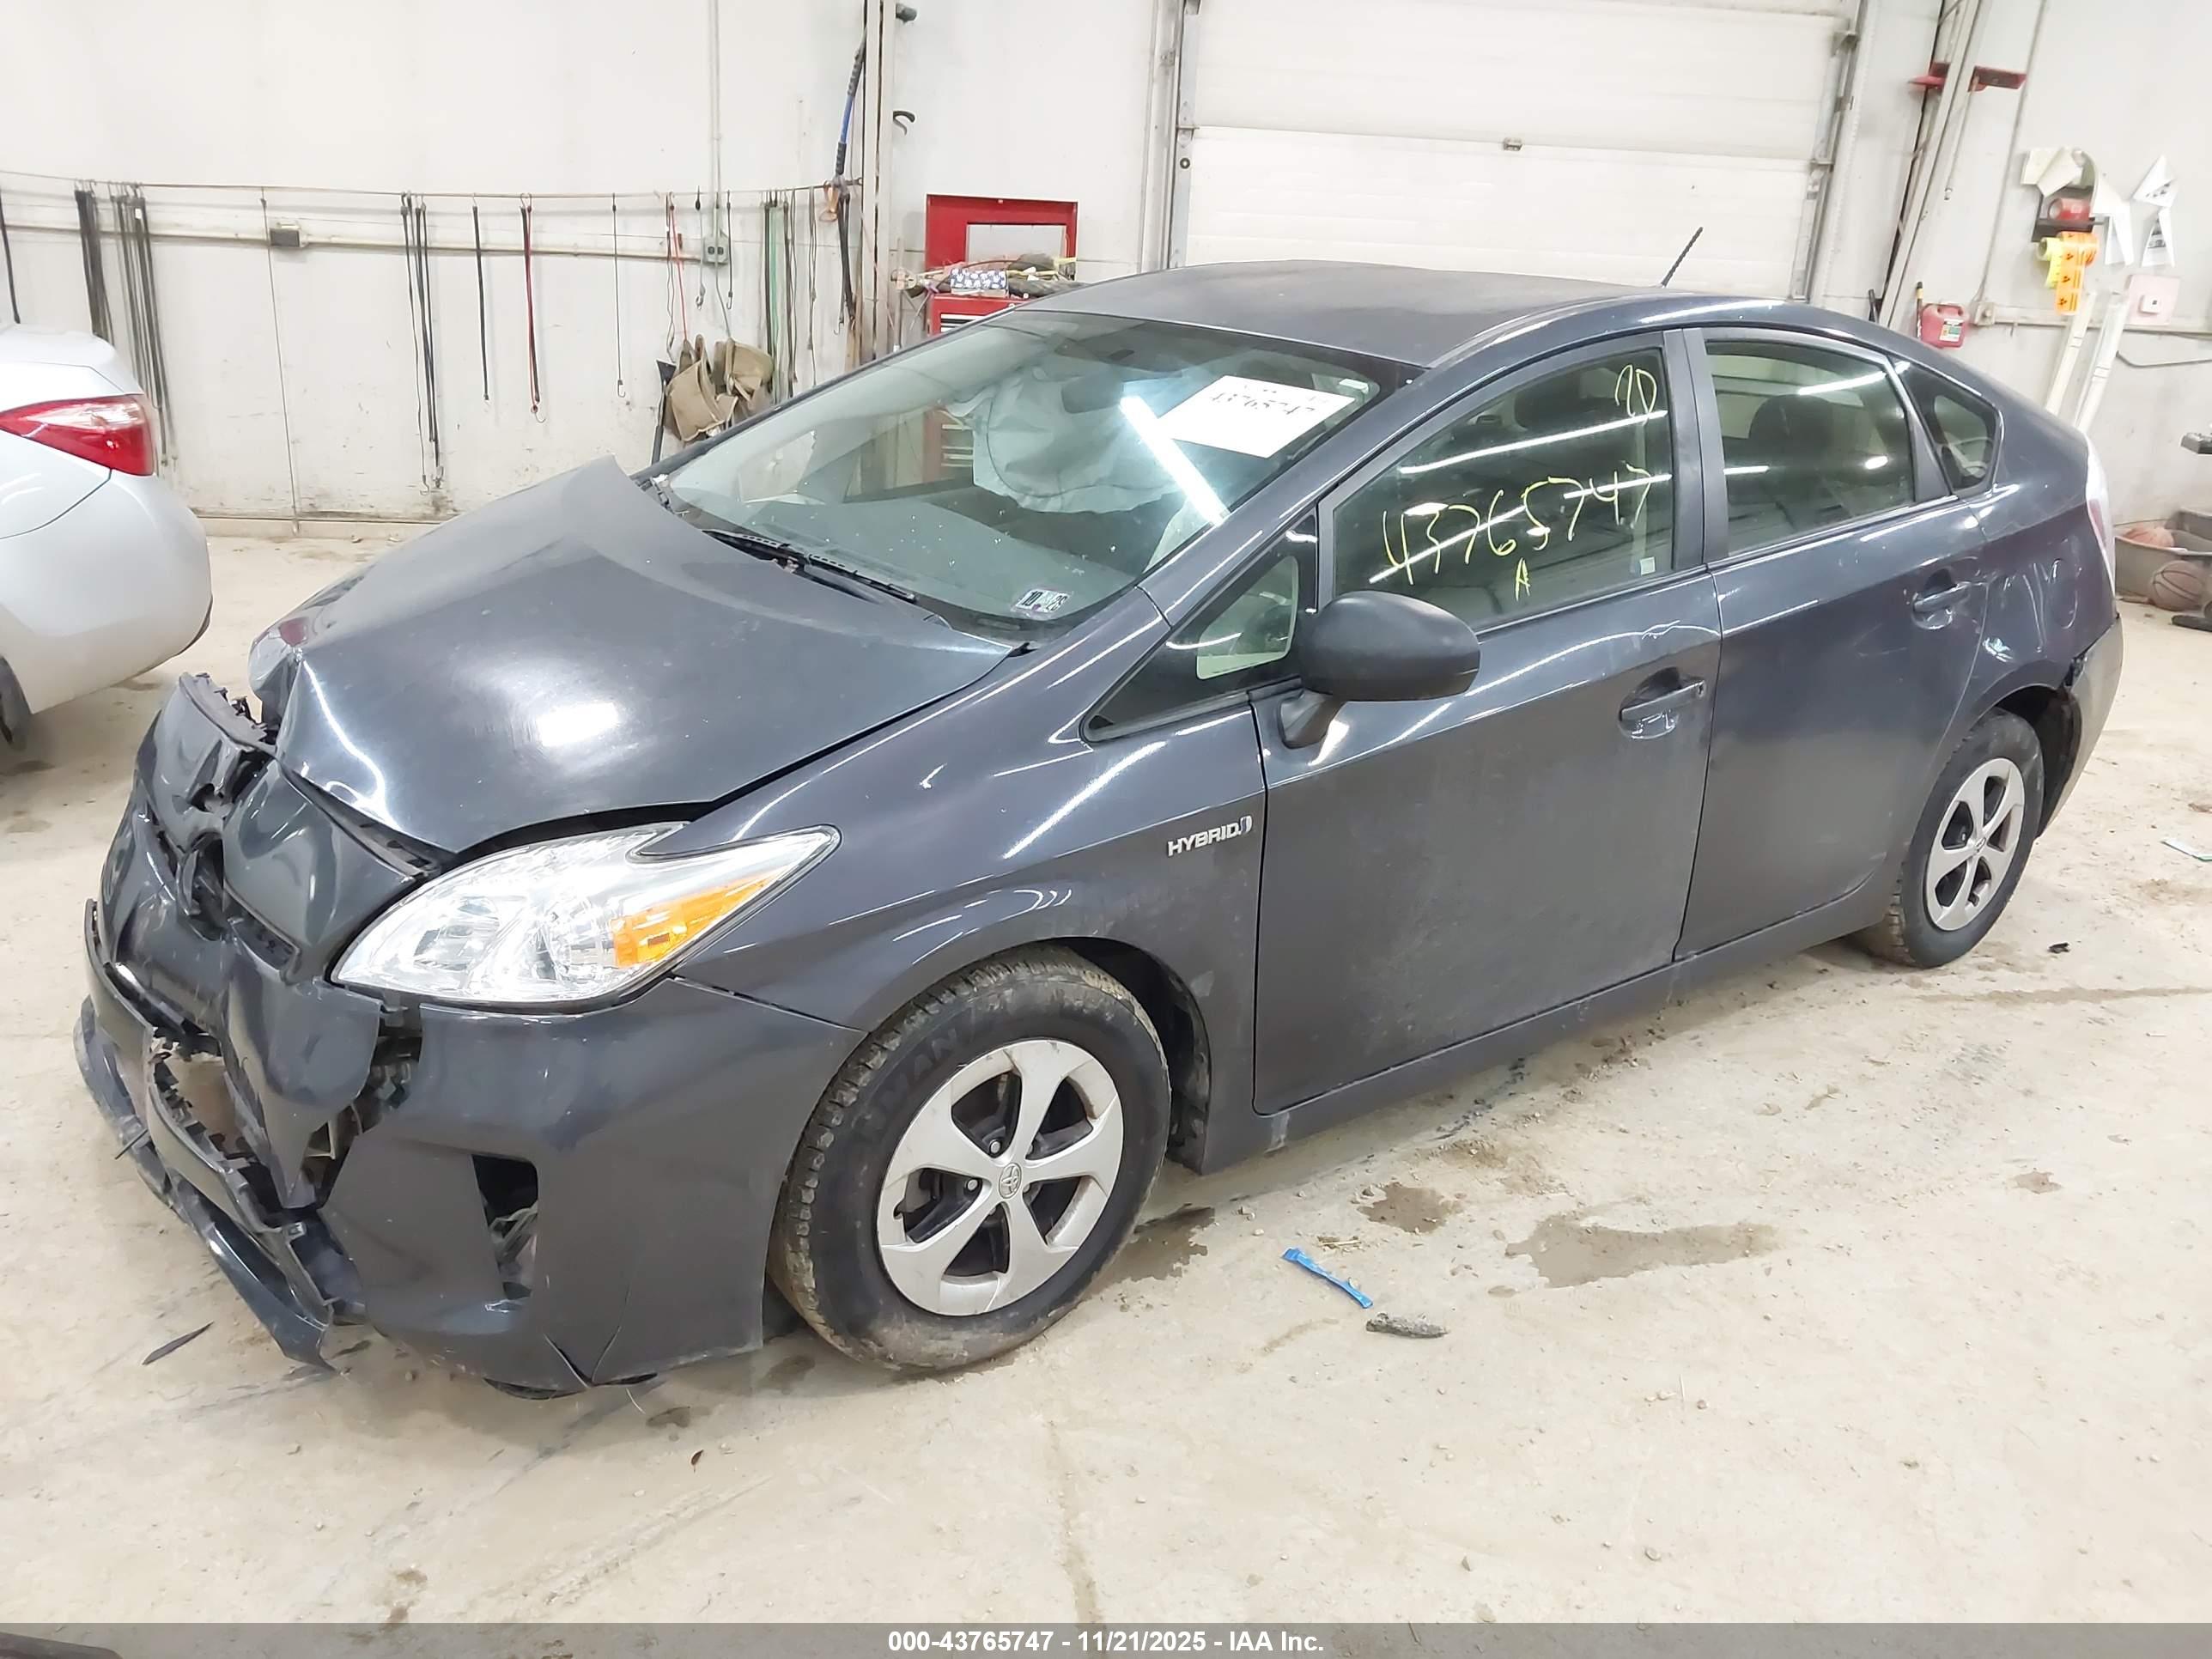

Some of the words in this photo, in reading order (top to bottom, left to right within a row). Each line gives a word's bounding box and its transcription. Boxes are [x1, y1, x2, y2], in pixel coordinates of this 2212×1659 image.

[1382, 461, 1653, 586] 43765747
[1514, 556, 1532, 602] A
[1167, 821, 1242, 857] HYBRID
